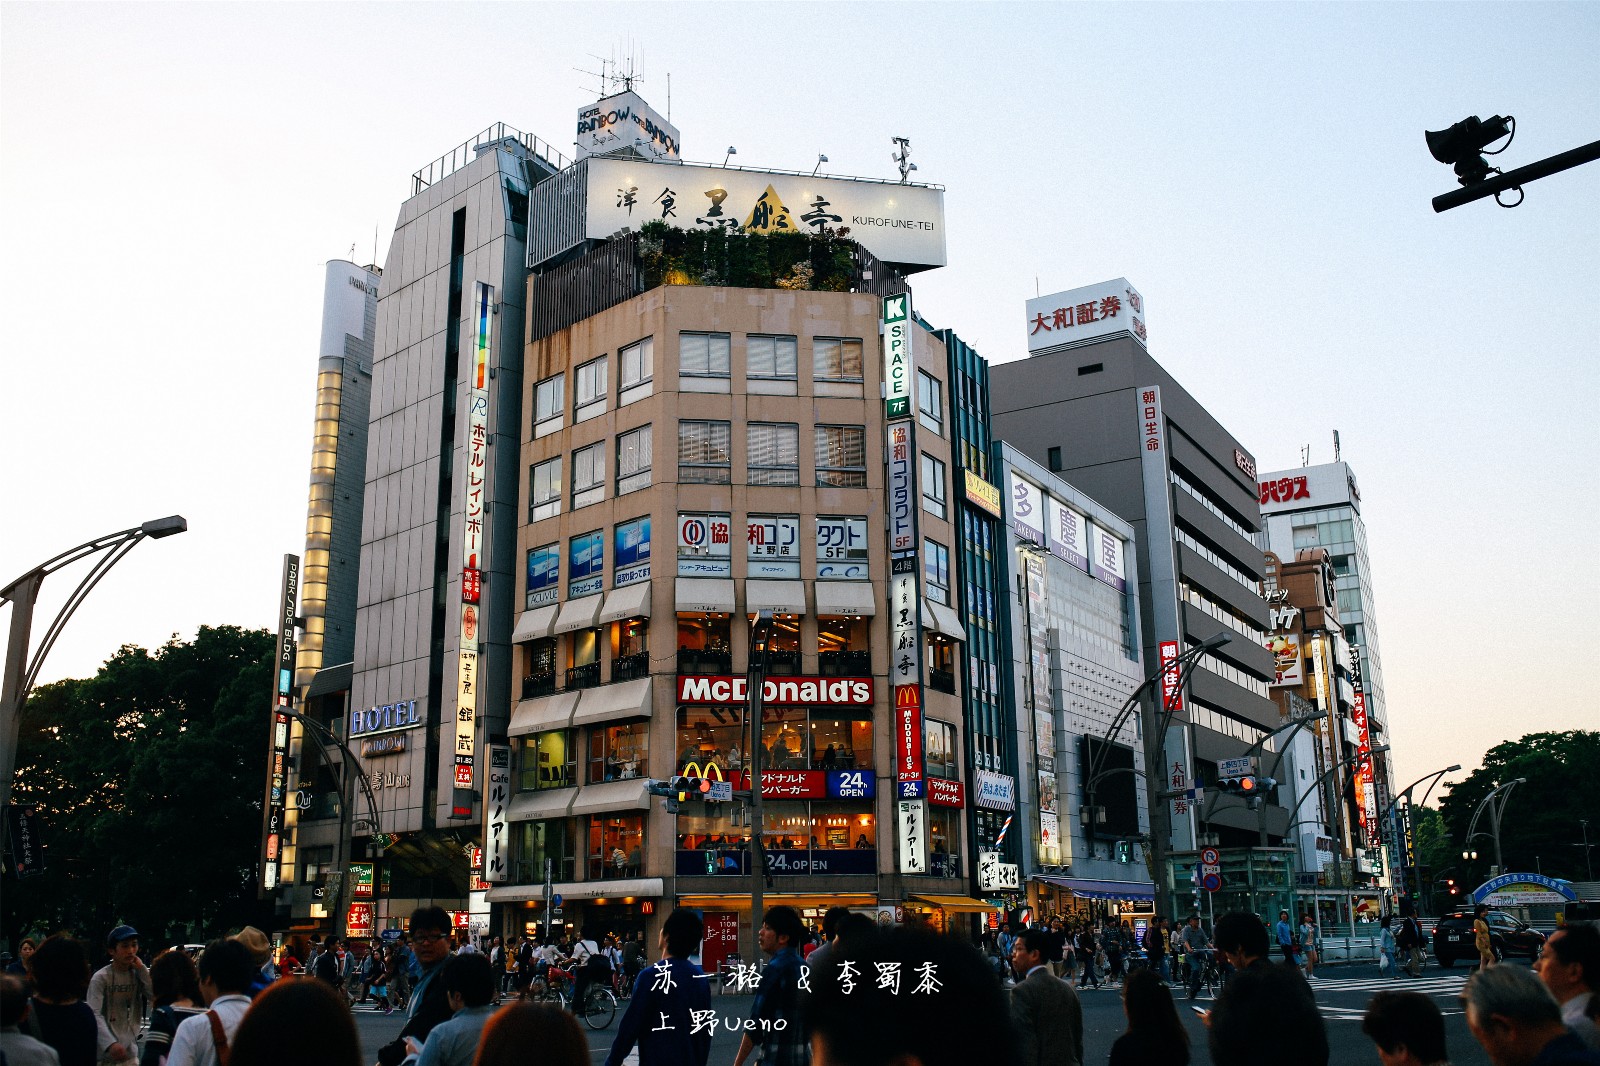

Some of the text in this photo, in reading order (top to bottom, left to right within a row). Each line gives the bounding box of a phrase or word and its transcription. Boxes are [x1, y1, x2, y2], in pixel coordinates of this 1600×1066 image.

[577, 106, 630, 135] RAINBOW
[580, 108, 601, 120] HOTEL
[616, 186, 677, 219] 洋食
[852, 215, 934, 231] KUROFUNE-TEI
[1030, 296, 1121, 336] 大和証券
[887, 297, 904, 393] K SPACE
[892, 401, 905, 412] 7F
[1143, 391, 1159, 451] 朝日生命
[467, 424, 485, 550] ホテルレインボー
[893, 427, 909, 535] 協和コンタクト
[752, 545, 845, 557] 上野店 5F
[895, 536, 910, 548] 5F
[1061, 547, 1080, 566] SELECT
[287, 563, 297, 594] PARK
[1260, 588, 1289, 602] ターツ
[285, 596, 295, 625] SIDE
[352, 701, 419, 734] HOTEL
[904, 710, 914, 770] McDonald's
[1221, 758, 1248, 769] 上野四丁目
[491, 774, 508, 783] Cafe
[840, 773, 868, 788] 24h
[932, 781, 959, 793] マクドナルド
[840, 789, 864, 797] OPEN
[490, 785, 505, 873] ルノアール
[906, 814, 918, 868] ルノアール
[792, 860, 828, 870] OPEN
[350, 913, 370, 924] 王将
